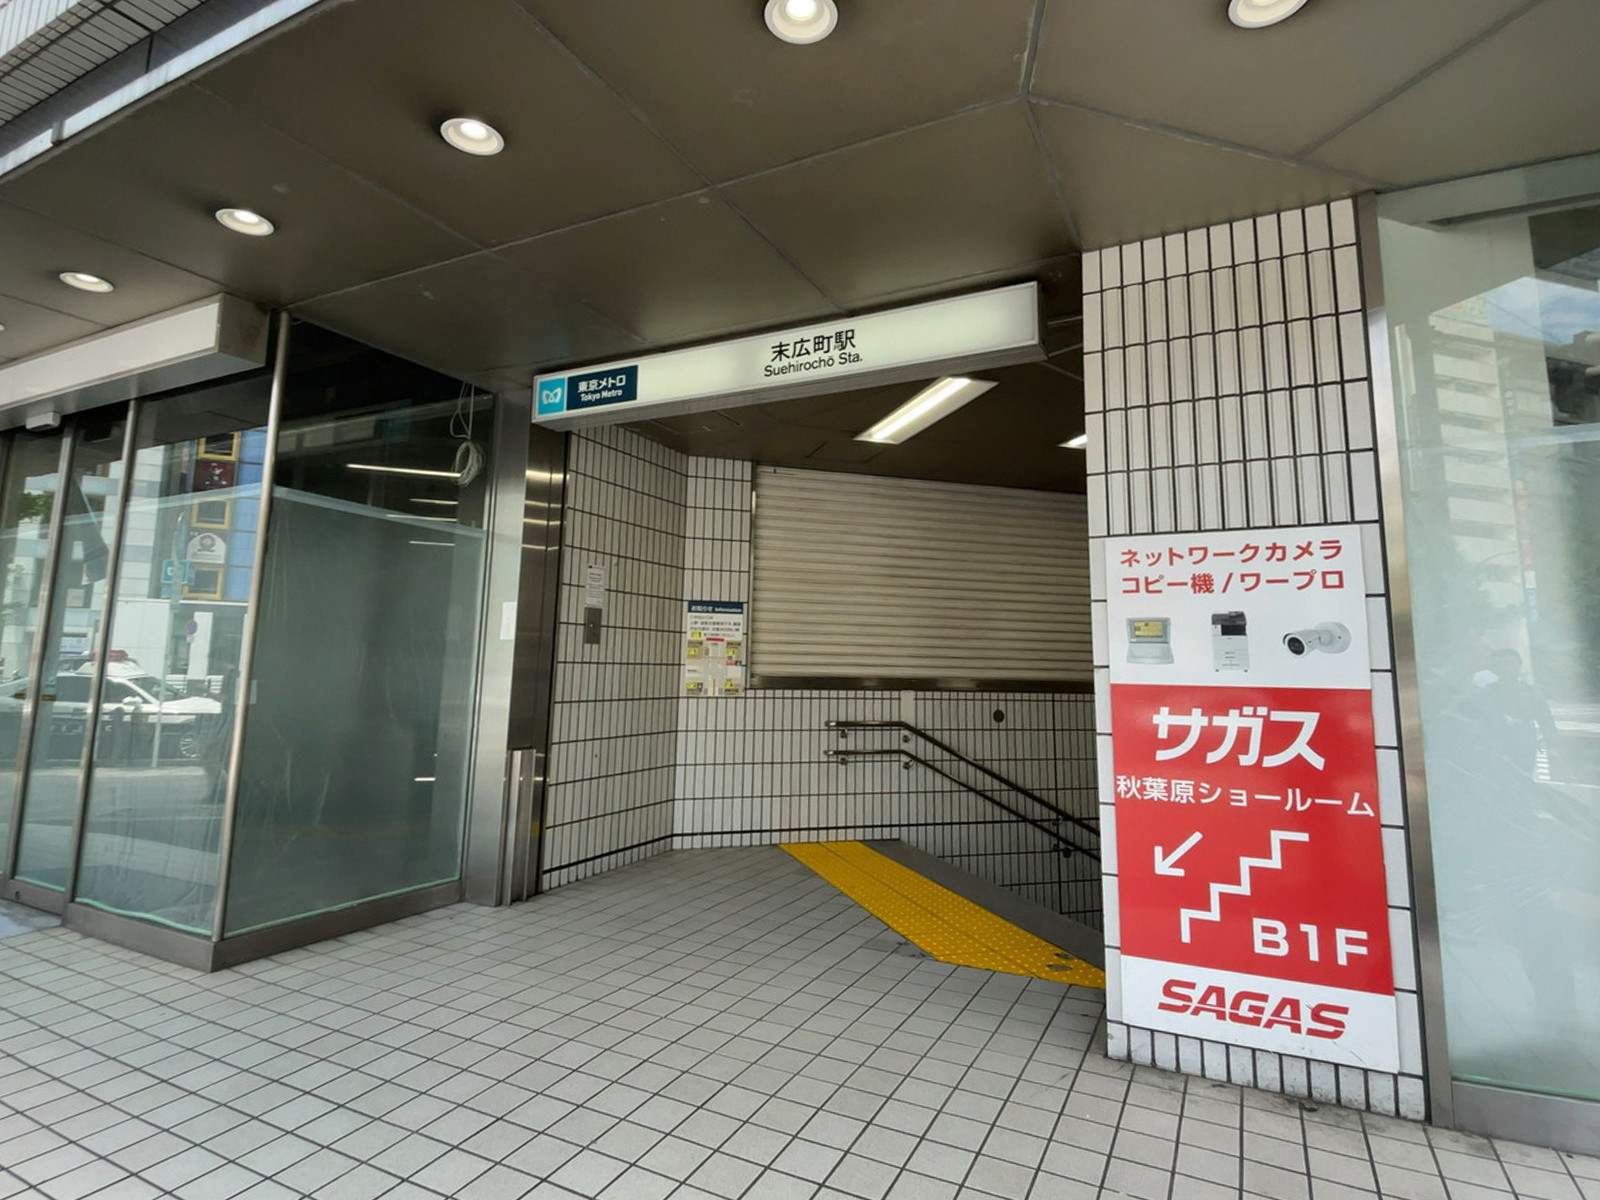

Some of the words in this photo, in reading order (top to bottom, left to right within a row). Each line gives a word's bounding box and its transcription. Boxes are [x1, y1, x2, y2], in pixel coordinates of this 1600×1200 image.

[771, 329, 856, 362] 末広町駅
[838, 352, 863, 365] Sta.
[578, 374, 626, 393] 東京メトロ
[580, 392, 601, 402] Tokyo
[601, 389, 623, 399] Metro
[1120, 540, 1342, 567] ネットワークカメラ
[1152, 706, 1325, 771] サガス
[1116, 775, 1374, 817] 秋葉原ショールーム
[1252, 917, 1368, 966] B1F
[1157, 979, 1350, 1040] SAGAS
